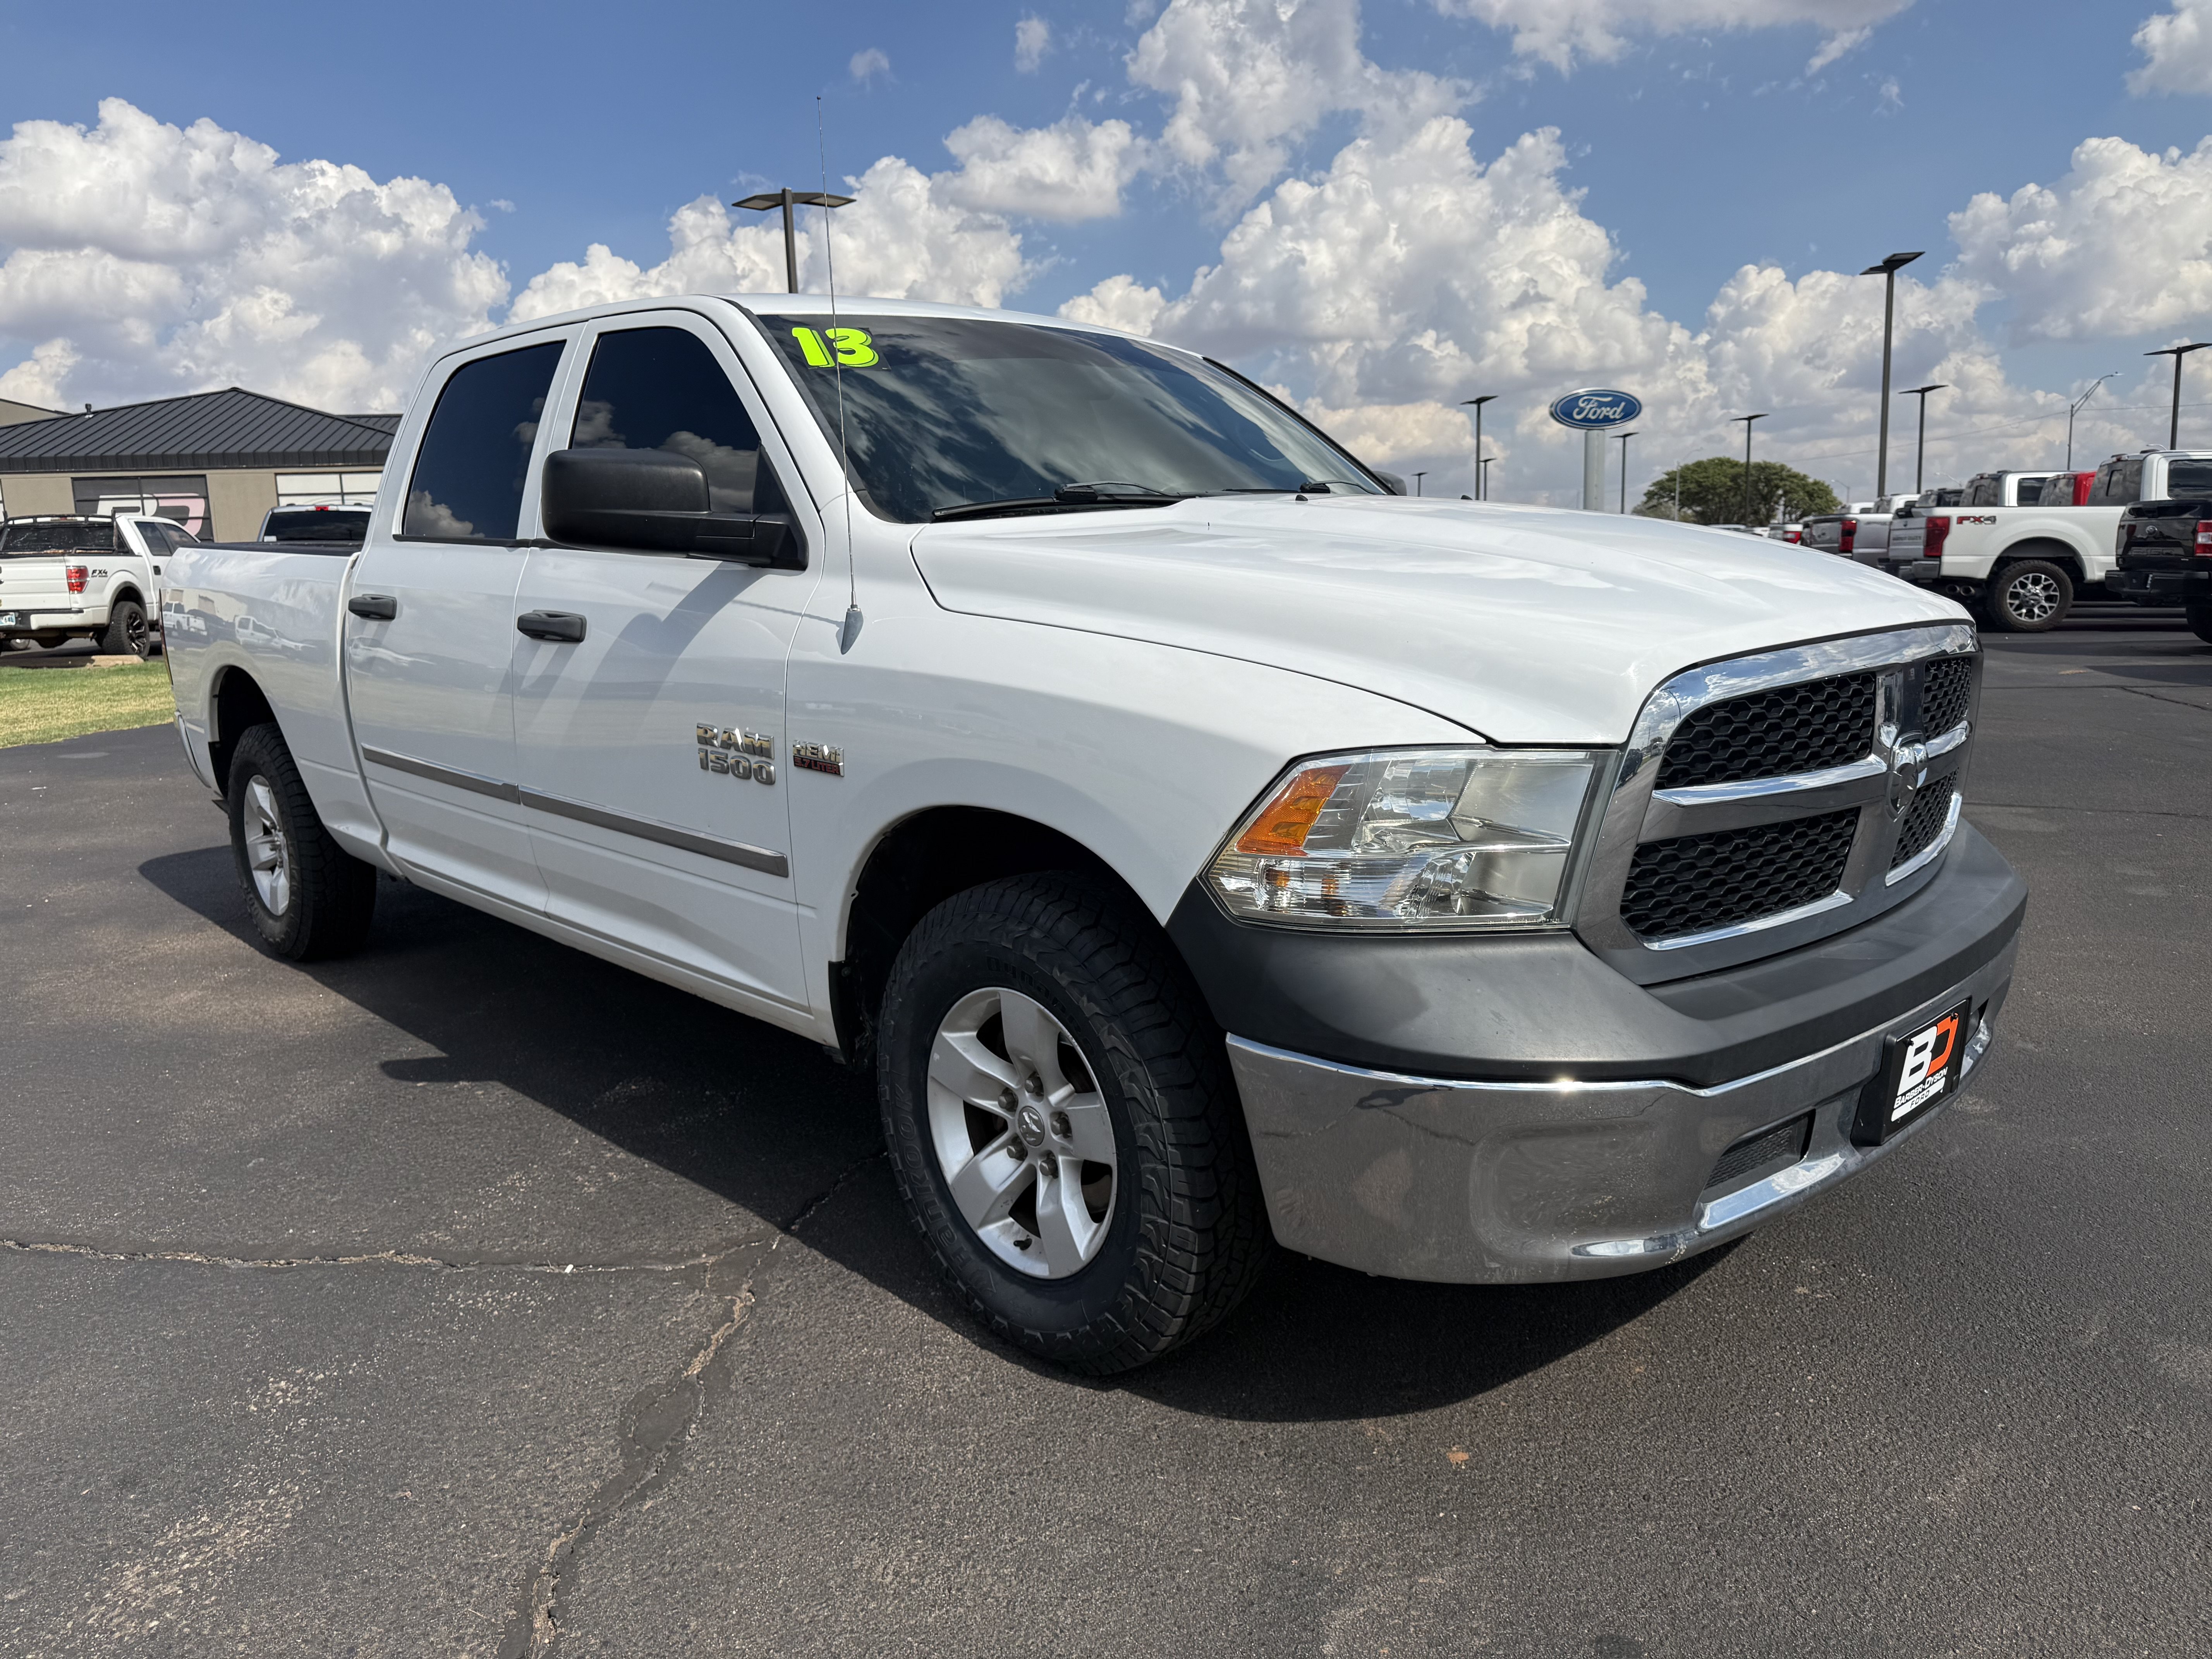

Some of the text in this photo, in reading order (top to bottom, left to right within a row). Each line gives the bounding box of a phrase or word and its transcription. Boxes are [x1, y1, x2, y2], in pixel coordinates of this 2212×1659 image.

[792, 327, 879, 367] 13
[1572, 396, 1626, 420] Ford
[1956, 515, 1996, 525] FX4
[696, 722, 775, 759] RAM
[793, 740, 844, 764] HEMI
[698, 748, 776, 785] 1500
[794, 757, 840, 775] 5.7 LITER
[1910, 1090, 1930, 1108] FORD
